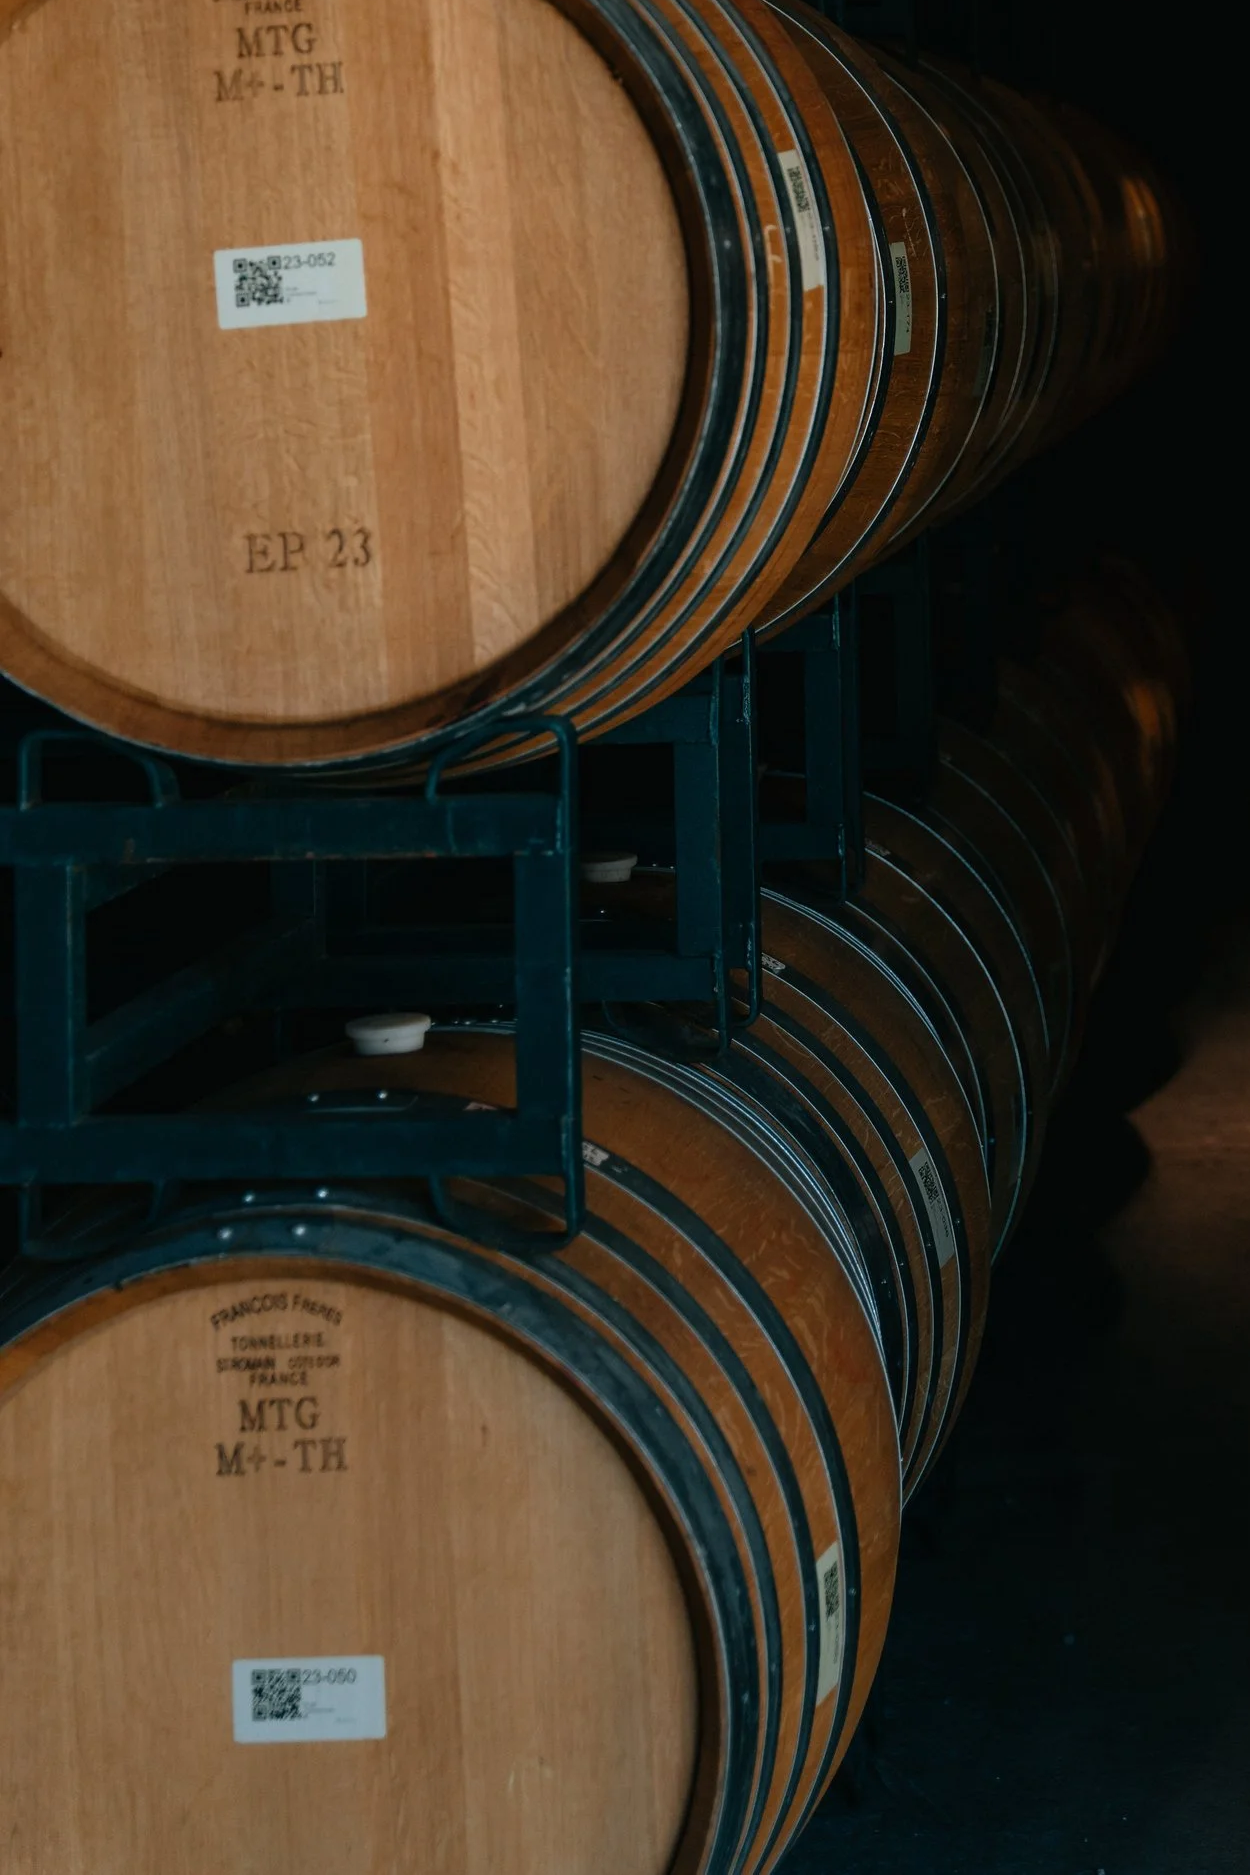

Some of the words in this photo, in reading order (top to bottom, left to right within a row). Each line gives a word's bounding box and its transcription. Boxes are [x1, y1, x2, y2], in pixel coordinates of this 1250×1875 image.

[236, 23, 317, 58] MTG
[282, 252, 336, 270] 23-052
[243, 531, 305, 574] EP
[325, 527, 371, 568] 23
[231, 1332, 324, 1351] TONNELLERIE
[250, 1371, 307, 1387] FRANCE
[238, 1396, 321, 1433] MTG
